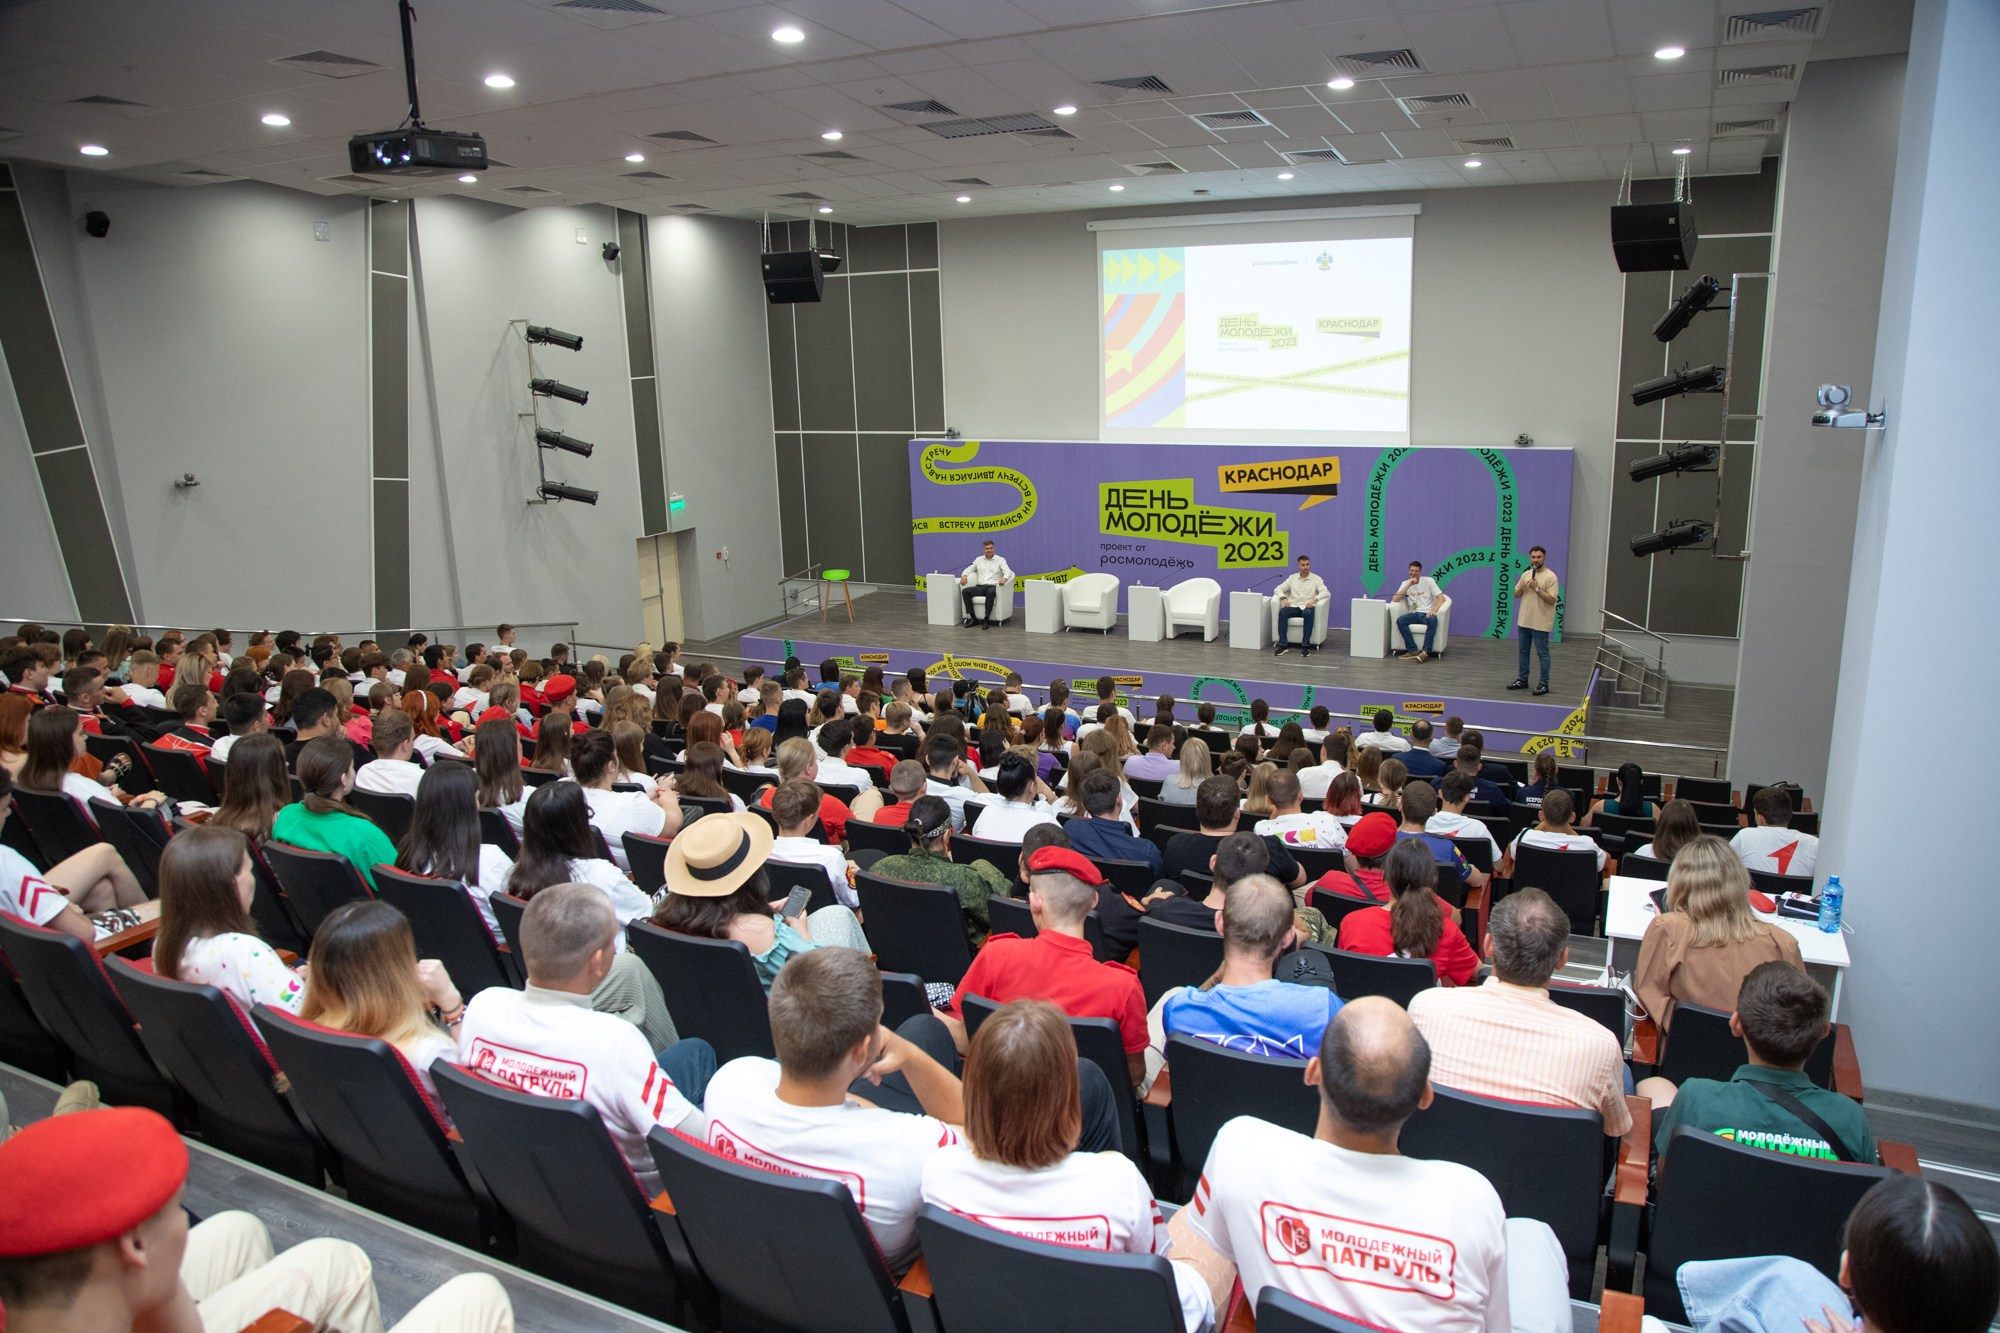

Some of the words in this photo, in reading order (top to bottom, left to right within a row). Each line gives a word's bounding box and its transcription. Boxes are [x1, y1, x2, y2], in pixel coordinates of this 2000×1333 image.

[1219, 317, 1257, 328] ДЕНЬ
[1318, 319, 1379, 329] КРАСНОДАР
[1271, 337, 1297, 348] 2023
[1225, 462, 1333, 484] КРАСНОДАР
[1105, 488, 1189, 511] ДЕНЬ
[1369, 462, 1390, 538] МОЛОДЁЖИ
[1502, 494, 1513, 523] 2023
[940, 521, 975, 529] ВСТРЕЧУ
[978, 513, 1023, 530] ДВИГАЙСЯ
[1105, 510, 1273, 538] МОЛОДЁЖИ
[1100, 543, 1133, 552] проект
[1135, 544, 1147, 552] от
[1224, 540, 1284, 563] 2023
[1500, 526, 1512, 558] ДЕНЬ
[1100, 555, 1195, 568] росмолодёжь
[1368, 540, 1379, 572] ДЕНЬ
[1455, 552, 1485, 567] 2023
[1491, 562, 1510, 639] МОЛОДЁЖИ
[1536, 736, 1555, 749] 023
[502, 1057, 577, 1082] МОЛОДЕЖНЫЙ
[1321, 1218, 1443, 1265] МОЛОДЕЖНЫЙ
[1321, 1243, 1441, 1285] ПАТРУЛЬ
